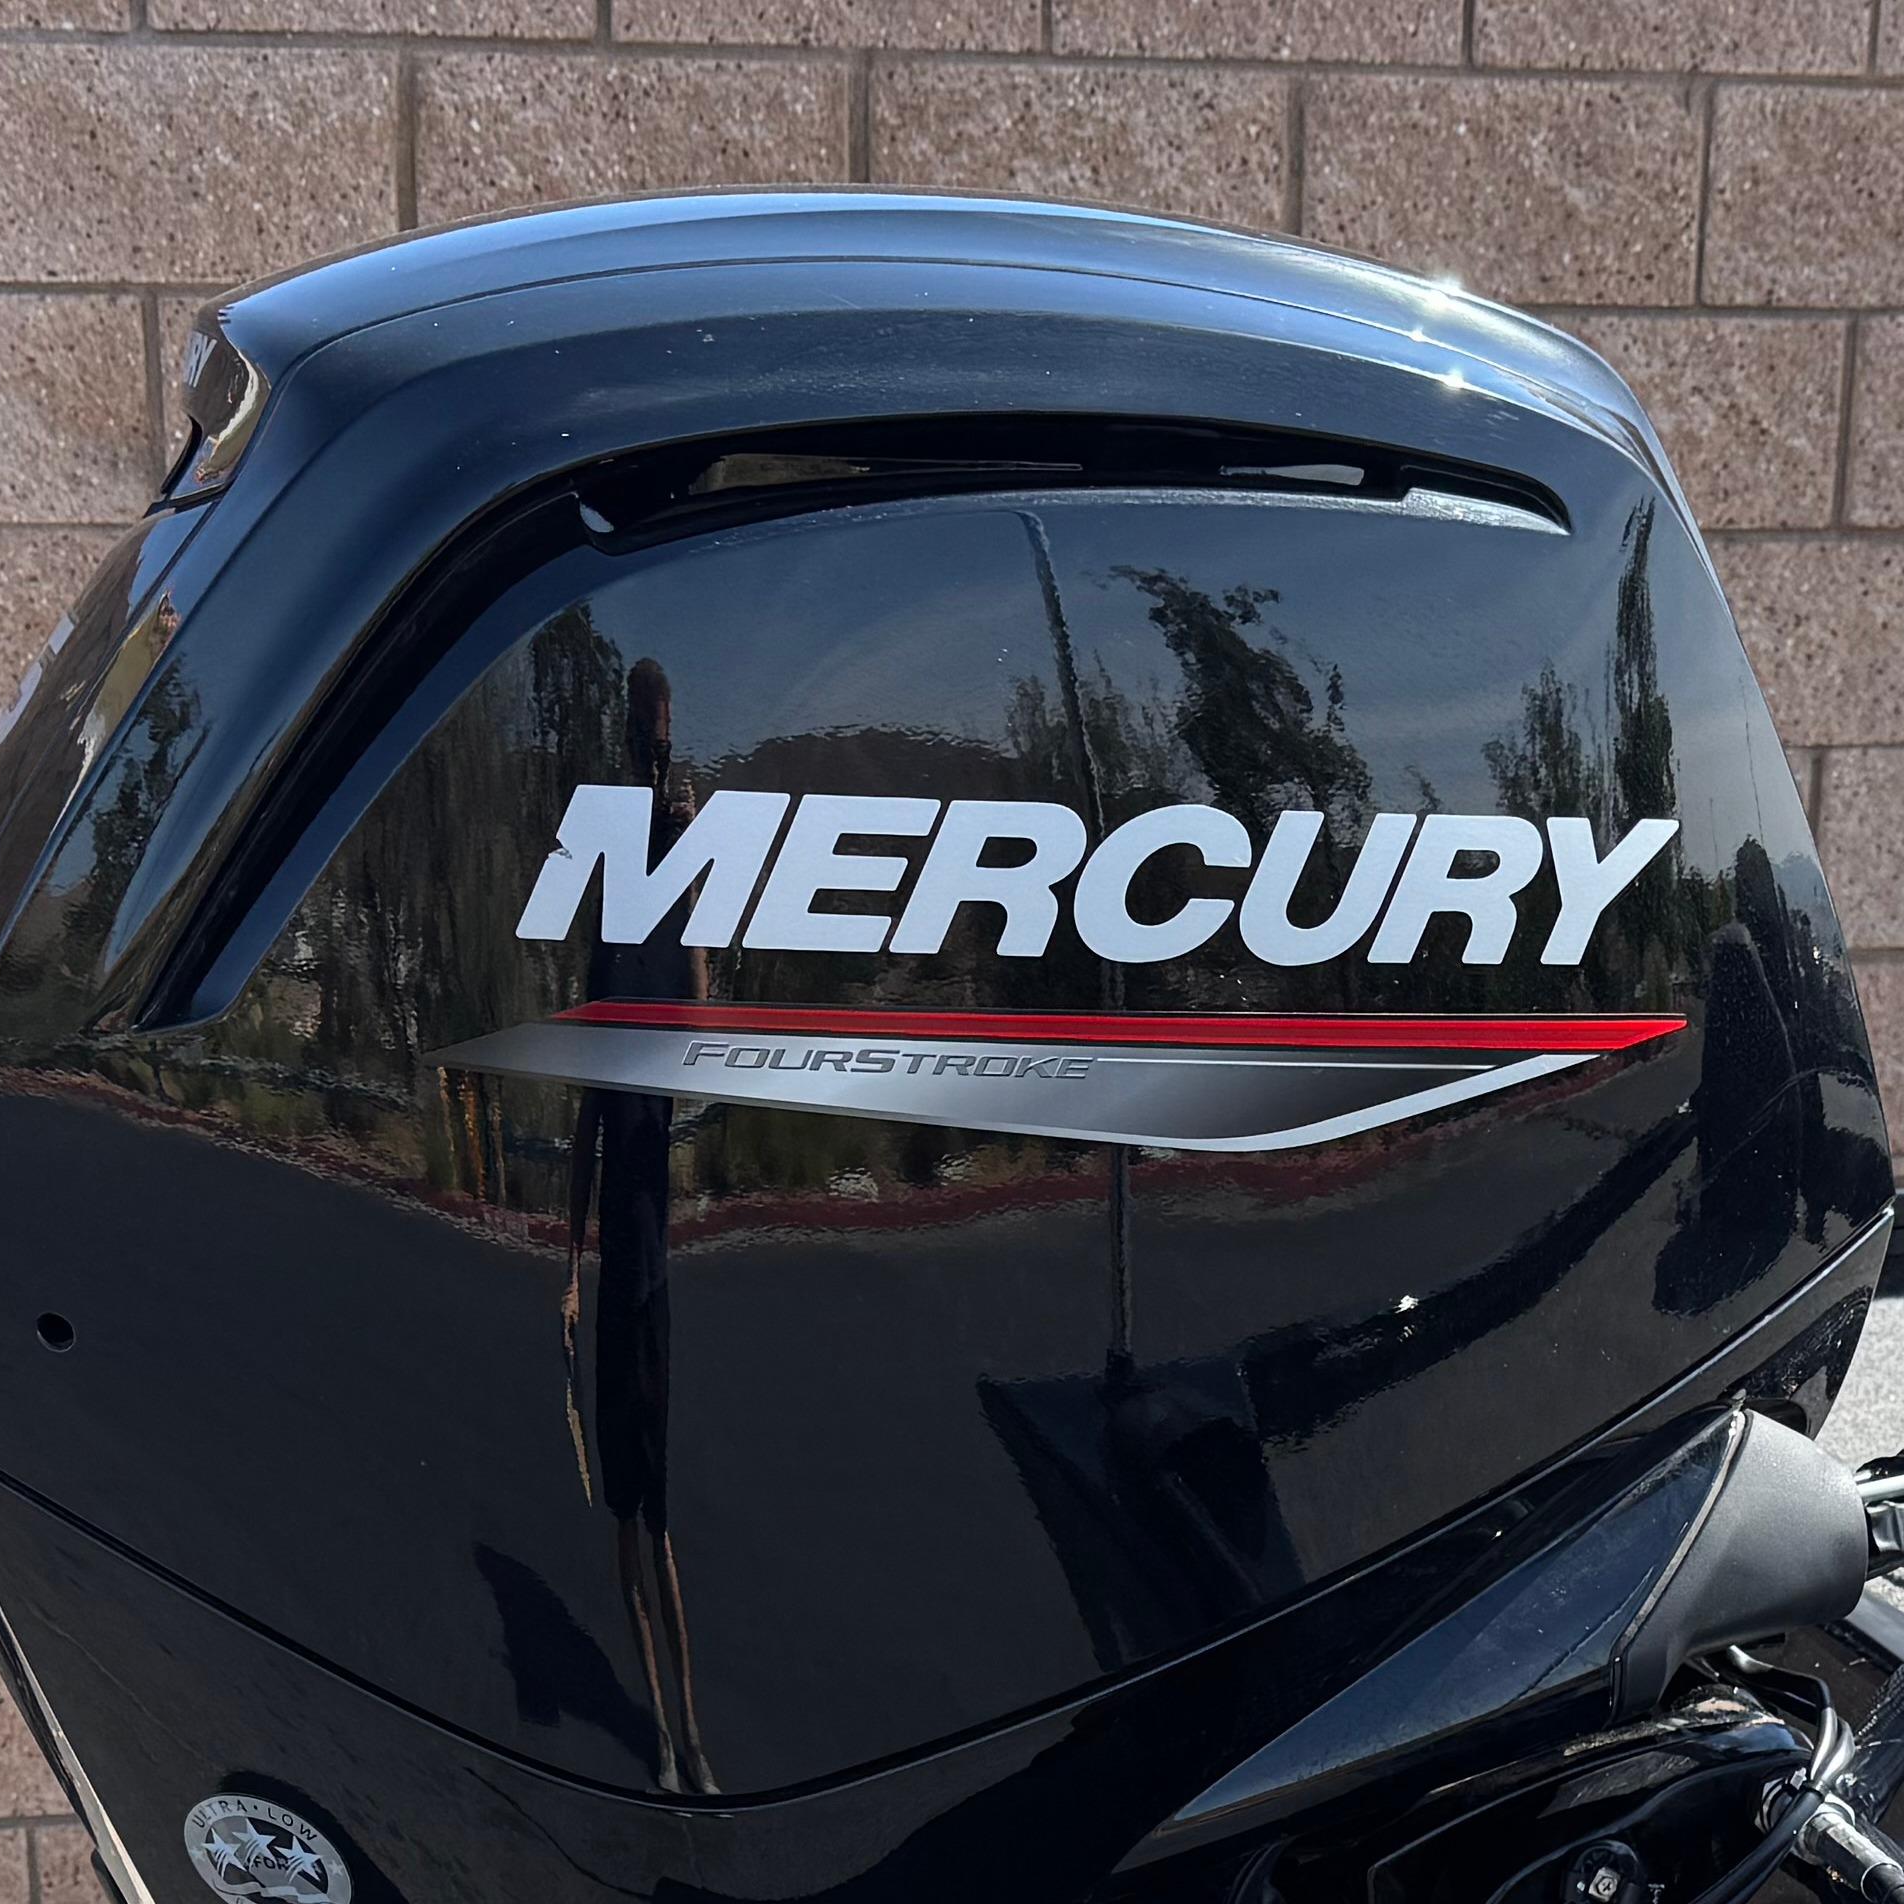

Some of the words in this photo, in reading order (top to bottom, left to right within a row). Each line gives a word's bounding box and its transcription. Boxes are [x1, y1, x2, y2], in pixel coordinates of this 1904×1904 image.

[514, 784, 1680, 966] MERCURY
[682, 1040, 1095, 1079] FOURSTROKE
[191, 1799, 248, 1829] ULTRA
[268, 1807, 317, 1841] LOW
